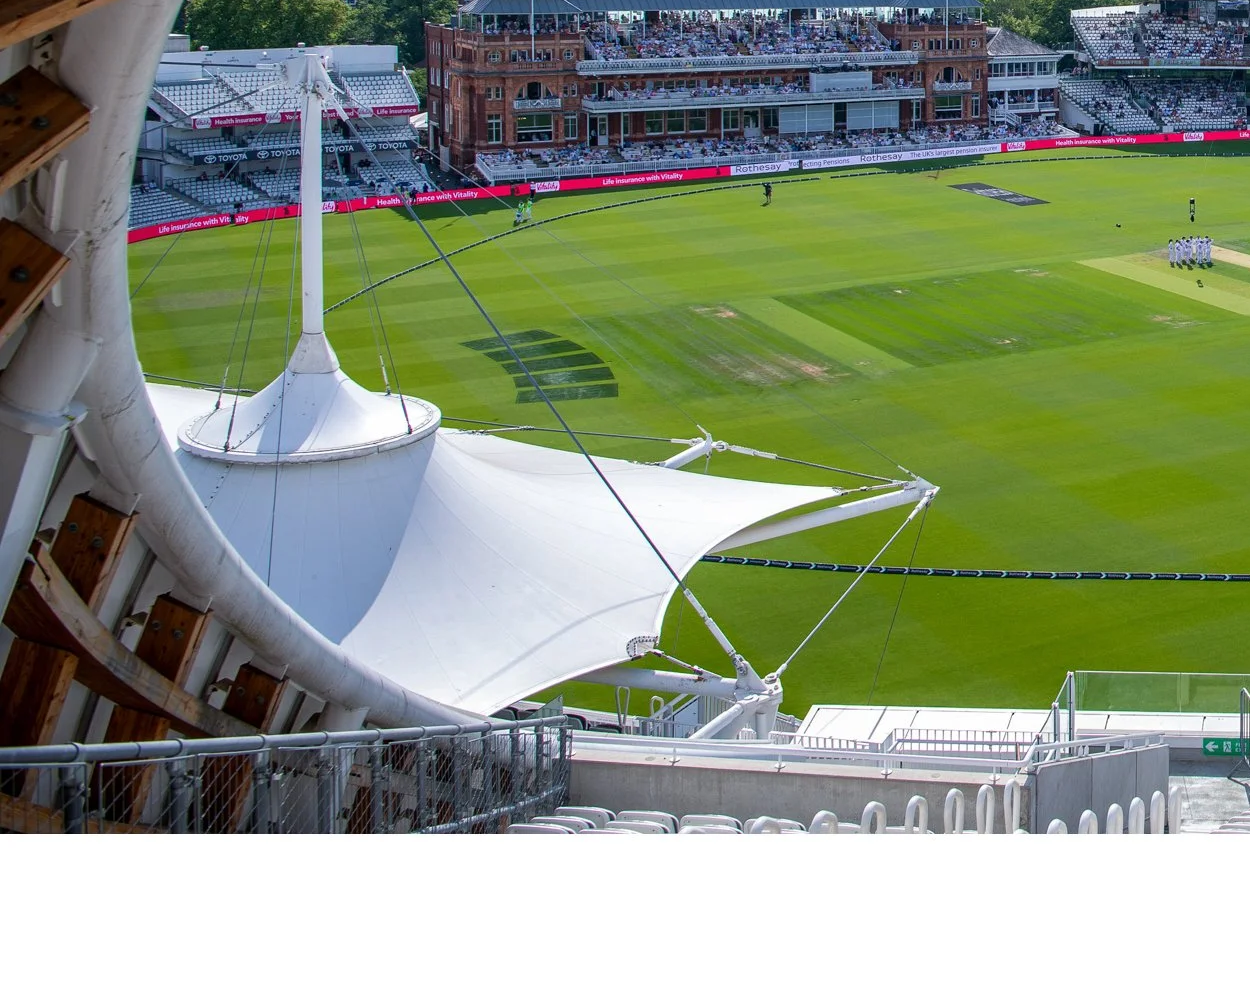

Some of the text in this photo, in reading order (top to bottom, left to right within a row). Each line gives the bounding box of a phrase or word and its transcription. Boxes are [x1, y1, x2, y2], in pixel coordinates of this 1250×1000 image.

[389, 107, 417, 115] insurance
[235, 116, 263, 124] insurance
[378, 142, 408, 150] TOYOTA
[1074, 138, 1102, 146] insurance
[1102, 137, 1116, 145] with
[1116, 136, 1137, 144] Vitality
[270, 148, 301, 157] TOYOTA
[325, 145, 354, 153] TOYOTA
[922, 150, 935, 158] UK's
[935, 149, 955, 158] largest
[956, 147, 978, 156] pension
[218, 153, 248, 162] TOYOTA
[823, 158, 850, 166] Pensions
[860, 152, 903, 163] Rothesay
[735, 162, 781, 174] Rothesay
[602, 177, 614, 186] Life
[615, 176, 645, 185] insurance
[661, 173, 684, 181] Vitality
[536, 181, 559, 192] Vitality
[377, 198, 401, 206] Health
[436, 192, 452, 201] with
[453, 190, 479, 200] Vitality
[158, 226, 170, 234] Life
[171, 221, 202, 232] insurance
[202, 216, 219, 227] with
